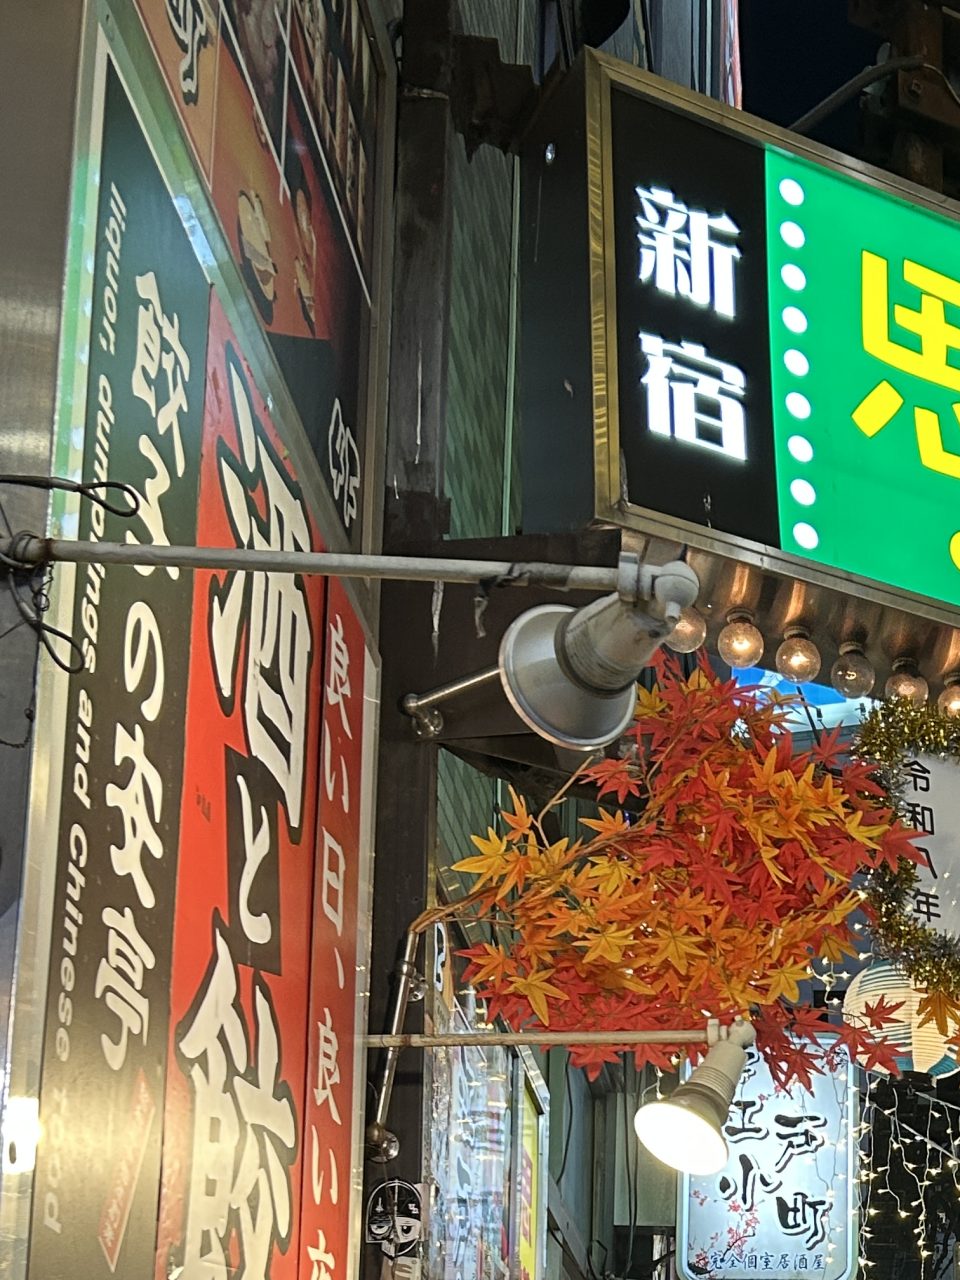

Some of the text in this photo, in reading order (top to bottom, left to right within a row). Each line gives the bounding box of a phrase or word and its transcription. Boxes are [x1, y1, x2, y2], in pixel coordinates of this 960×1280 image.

[99, 182, 128, 355] liquor,
[633, 184, 750, 464] 新宿
[82, 377, 115, 674] dumpings
[73, 691, 93, 809] and
[56, 822, 89, 1063] Chinese
